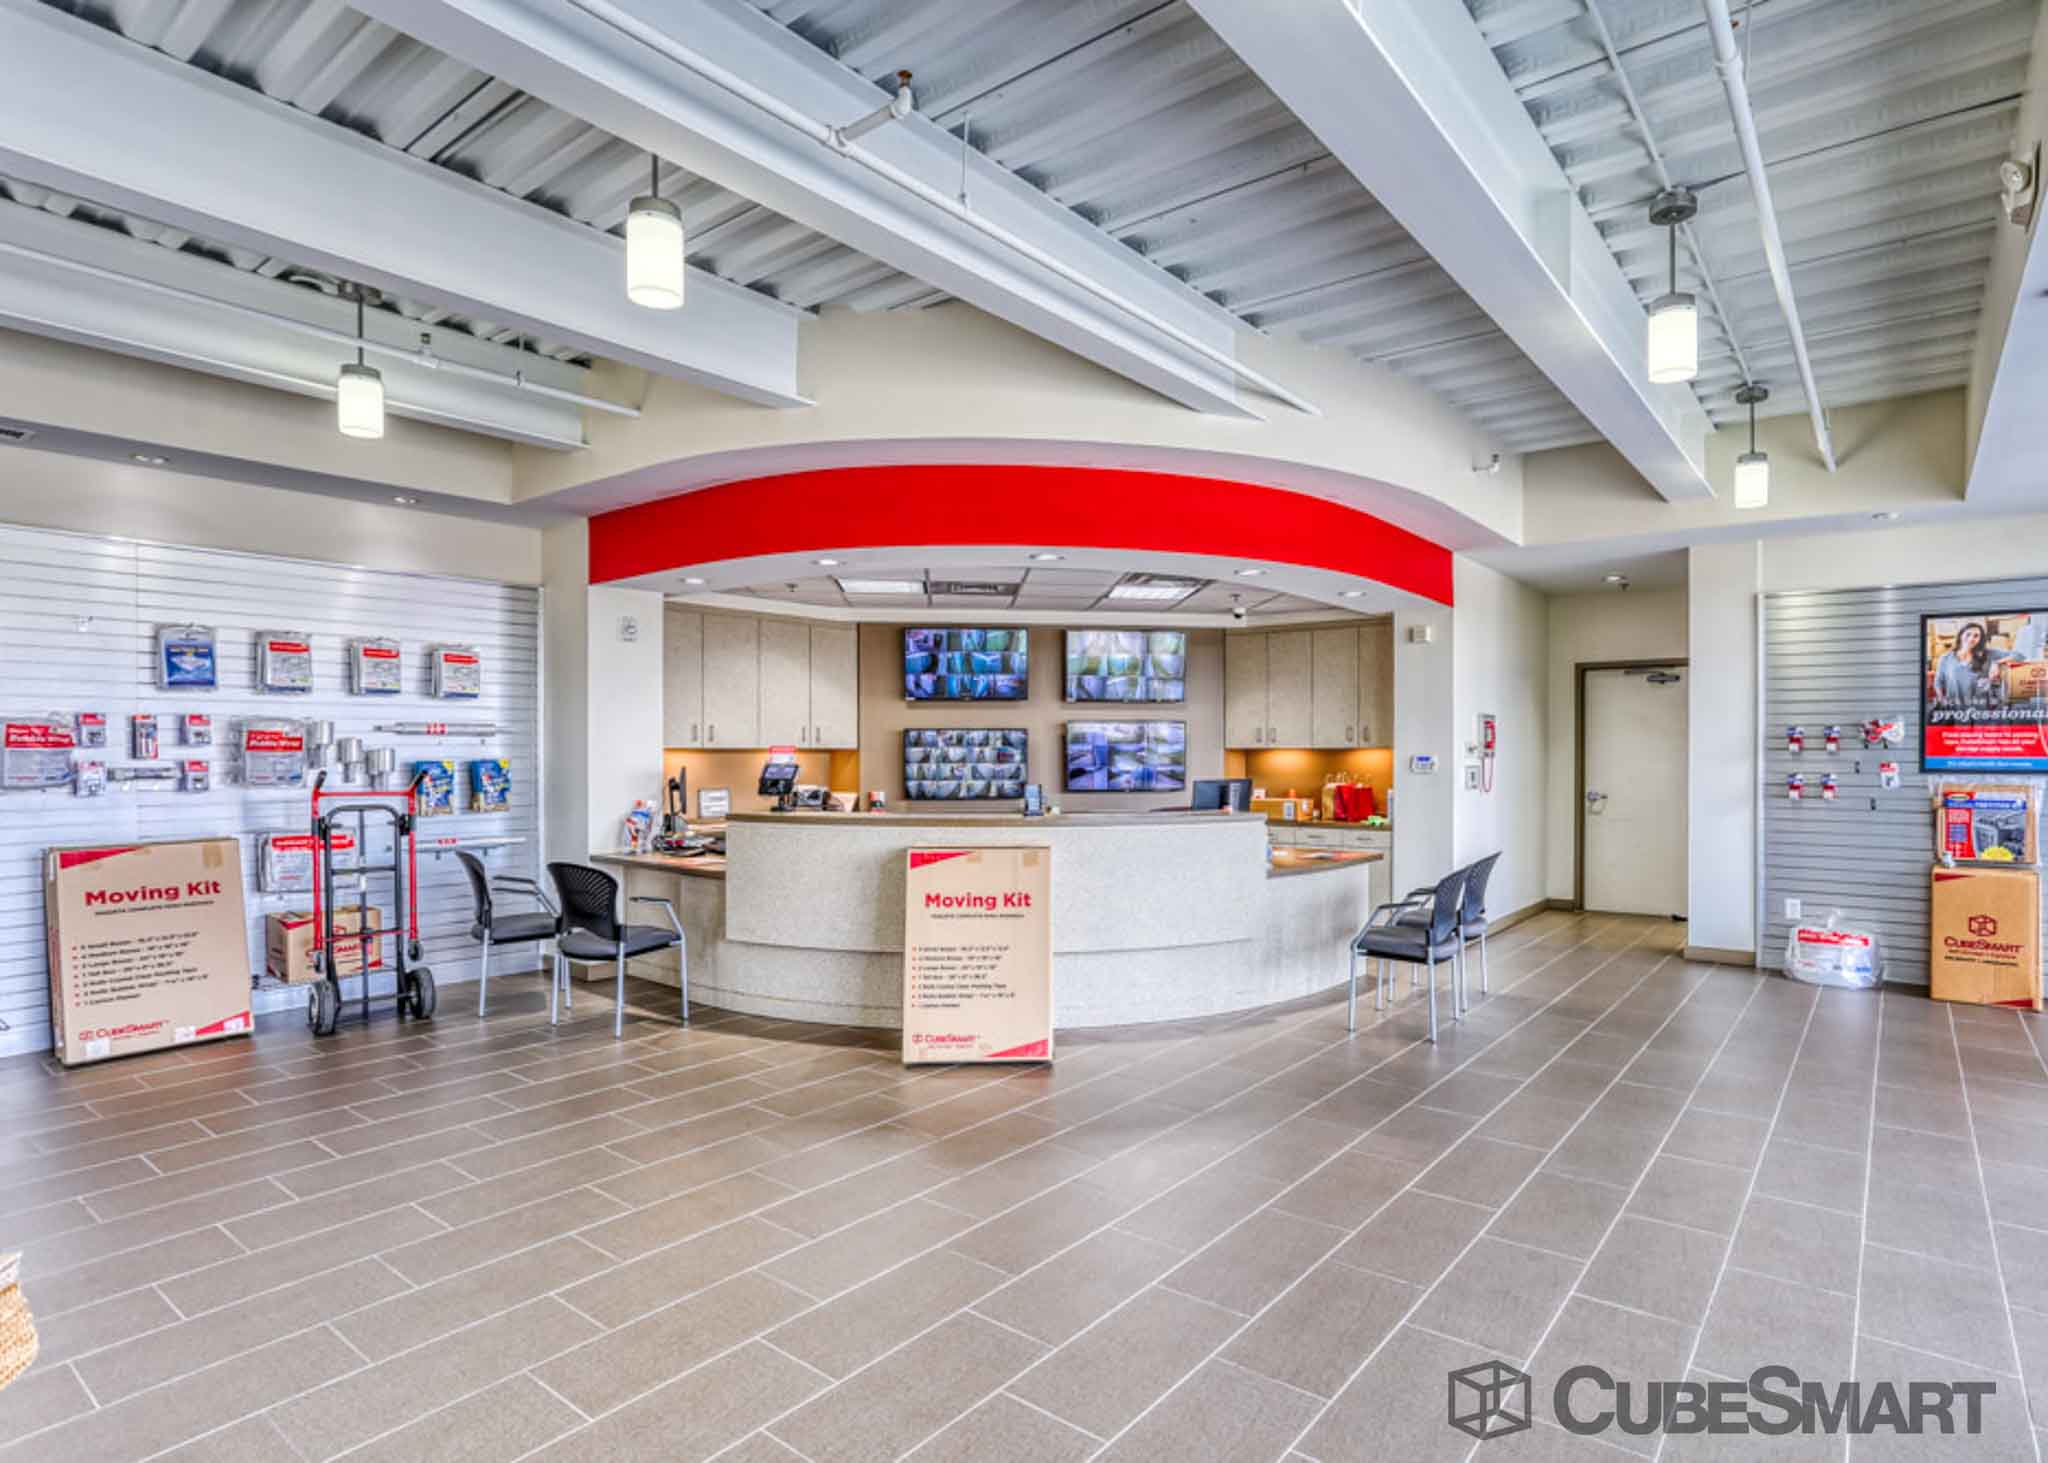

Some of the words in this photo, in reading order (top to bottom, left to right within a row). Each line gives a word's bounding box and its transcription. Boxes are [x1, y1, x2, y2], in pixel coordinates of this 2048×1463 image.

[84, 885, 180, 906] Moving
[187, 880, 222, 897] Kit
[924, 892, 997, 911] Moving
[1003, 892, 1032, 908] Kit
